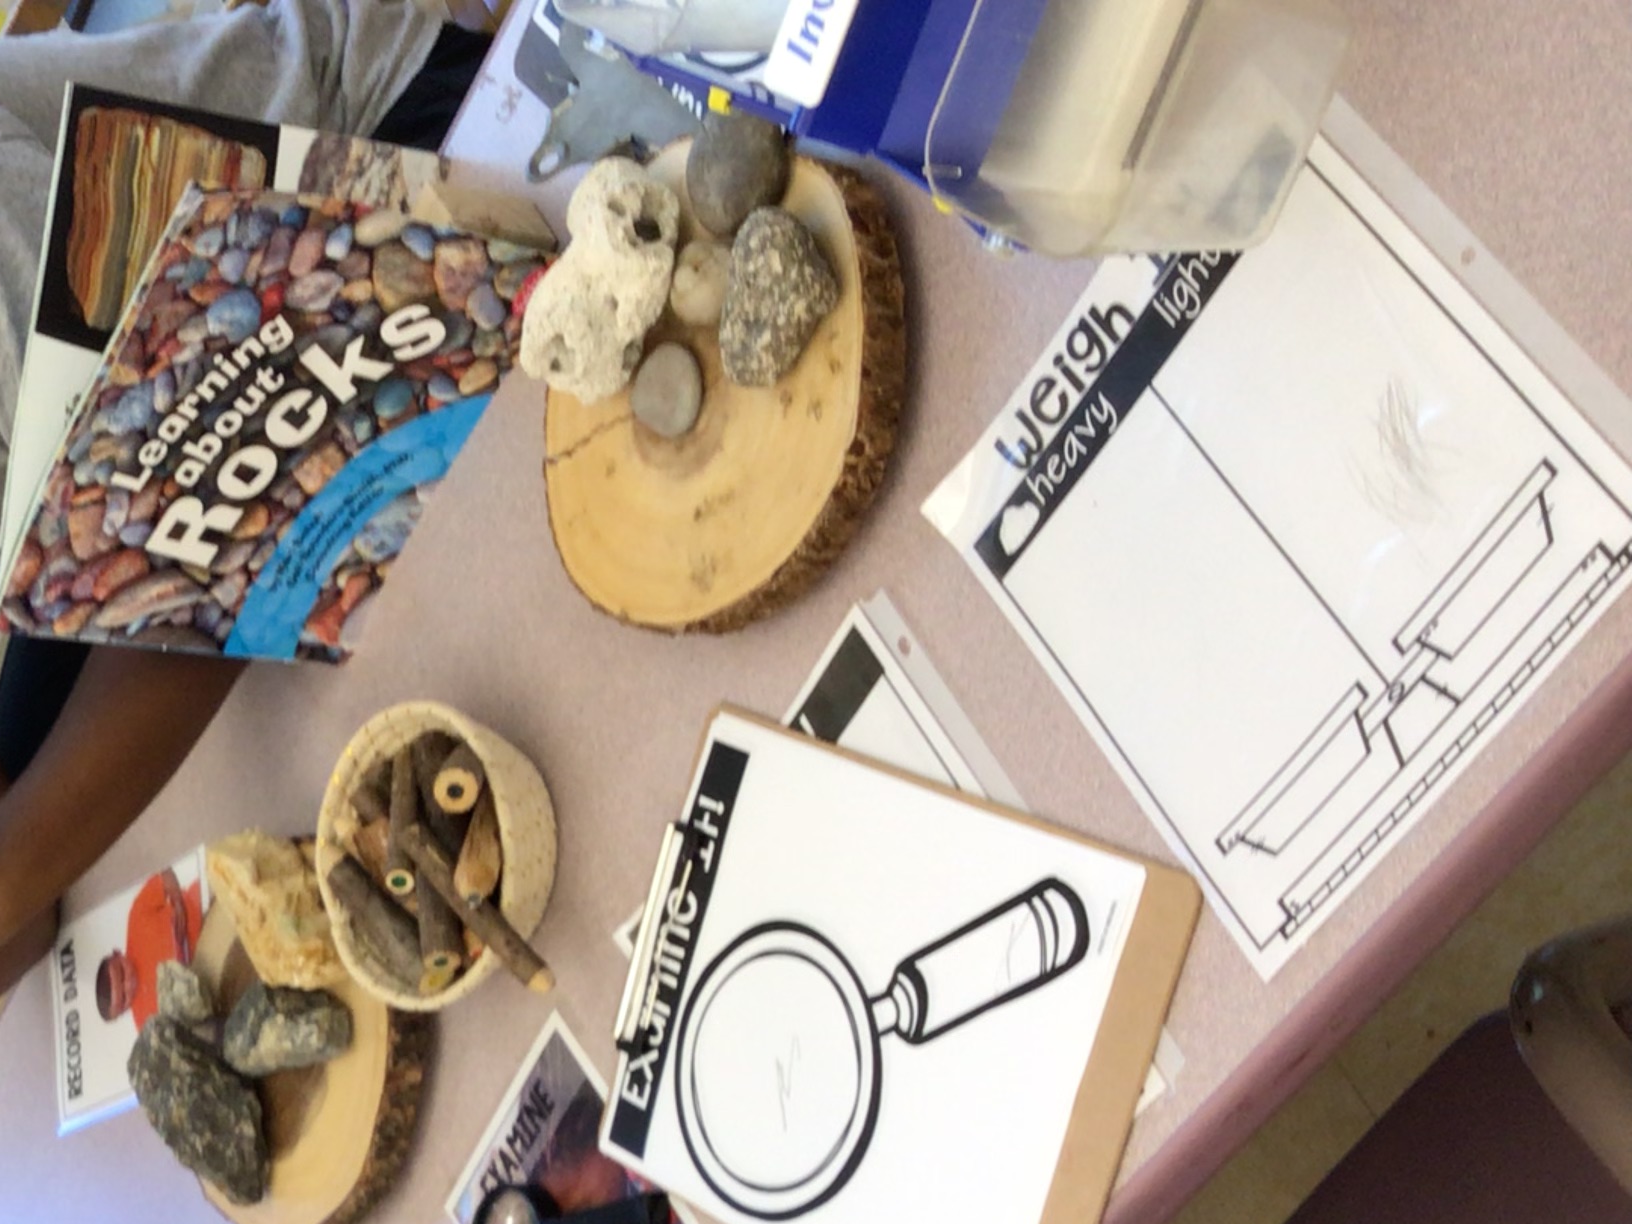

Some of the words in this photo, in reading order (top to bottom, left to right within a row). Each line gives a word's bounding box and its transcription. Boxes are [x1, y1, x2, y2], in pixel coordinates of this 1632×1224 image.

[111, 312, 294, 492] Learning
[173, 366, 285, 487] about
[994, 301, 1137, 471] Weigh
[1024, 391, 1118, 506] heavy
[59, 938, 78, 1002] DATA
[64, 1008, 83, 1100] RECORD
[479, 1077, 555, 1196] EXAMINE
